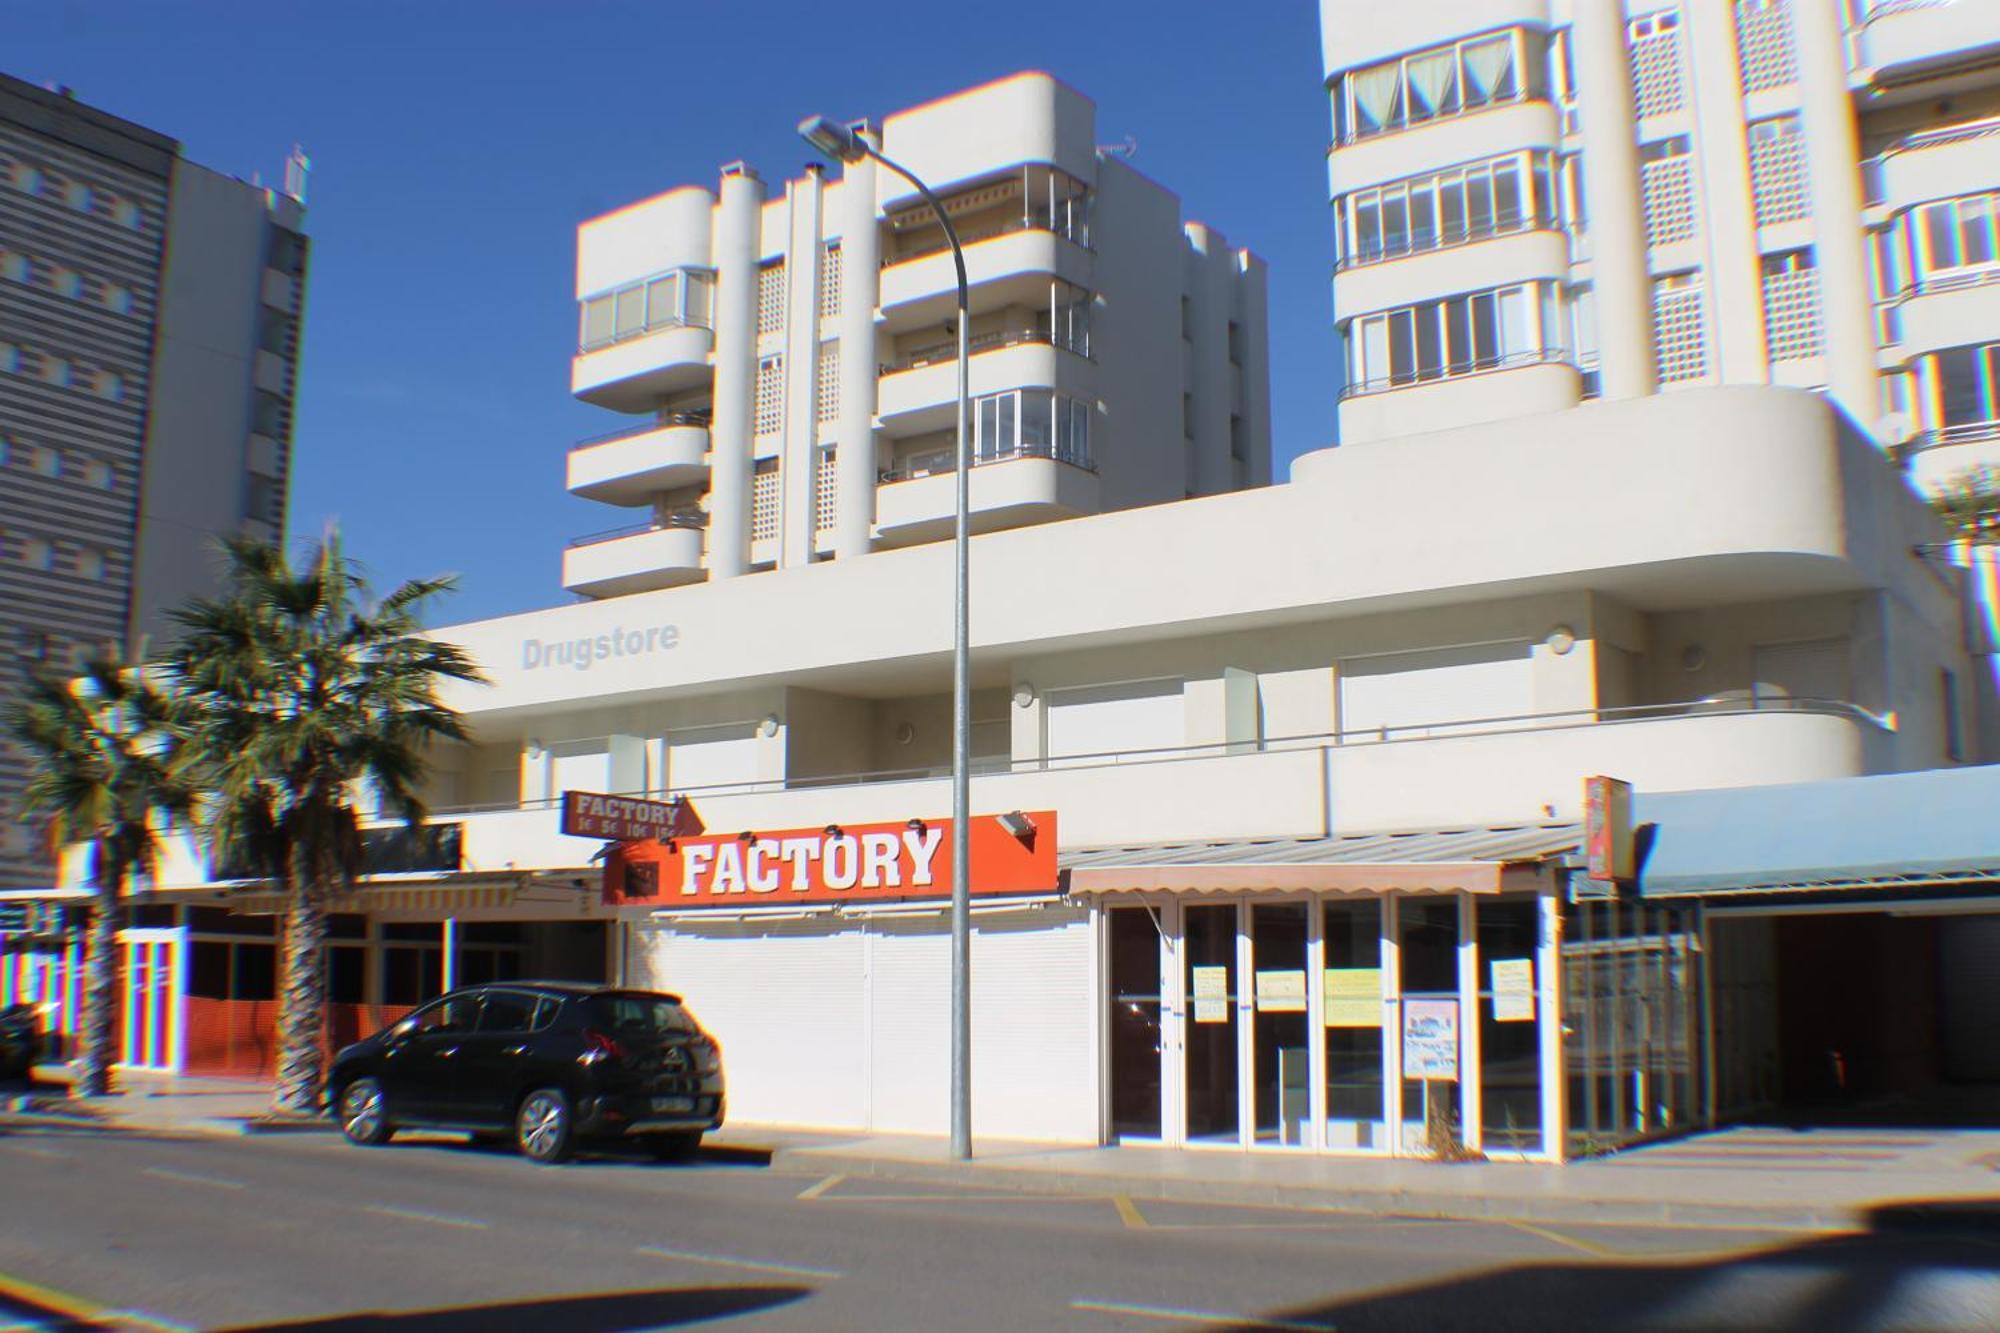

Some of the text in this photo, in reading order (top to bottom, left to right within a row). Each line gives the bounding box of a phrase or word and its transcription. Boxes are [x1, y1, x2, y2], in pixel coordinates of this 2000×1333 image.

[523, 624, 679, 671] Drugstore
[576, 795, 679, 825] FACTORY
[681, 828, 943, 895] FACTORY
